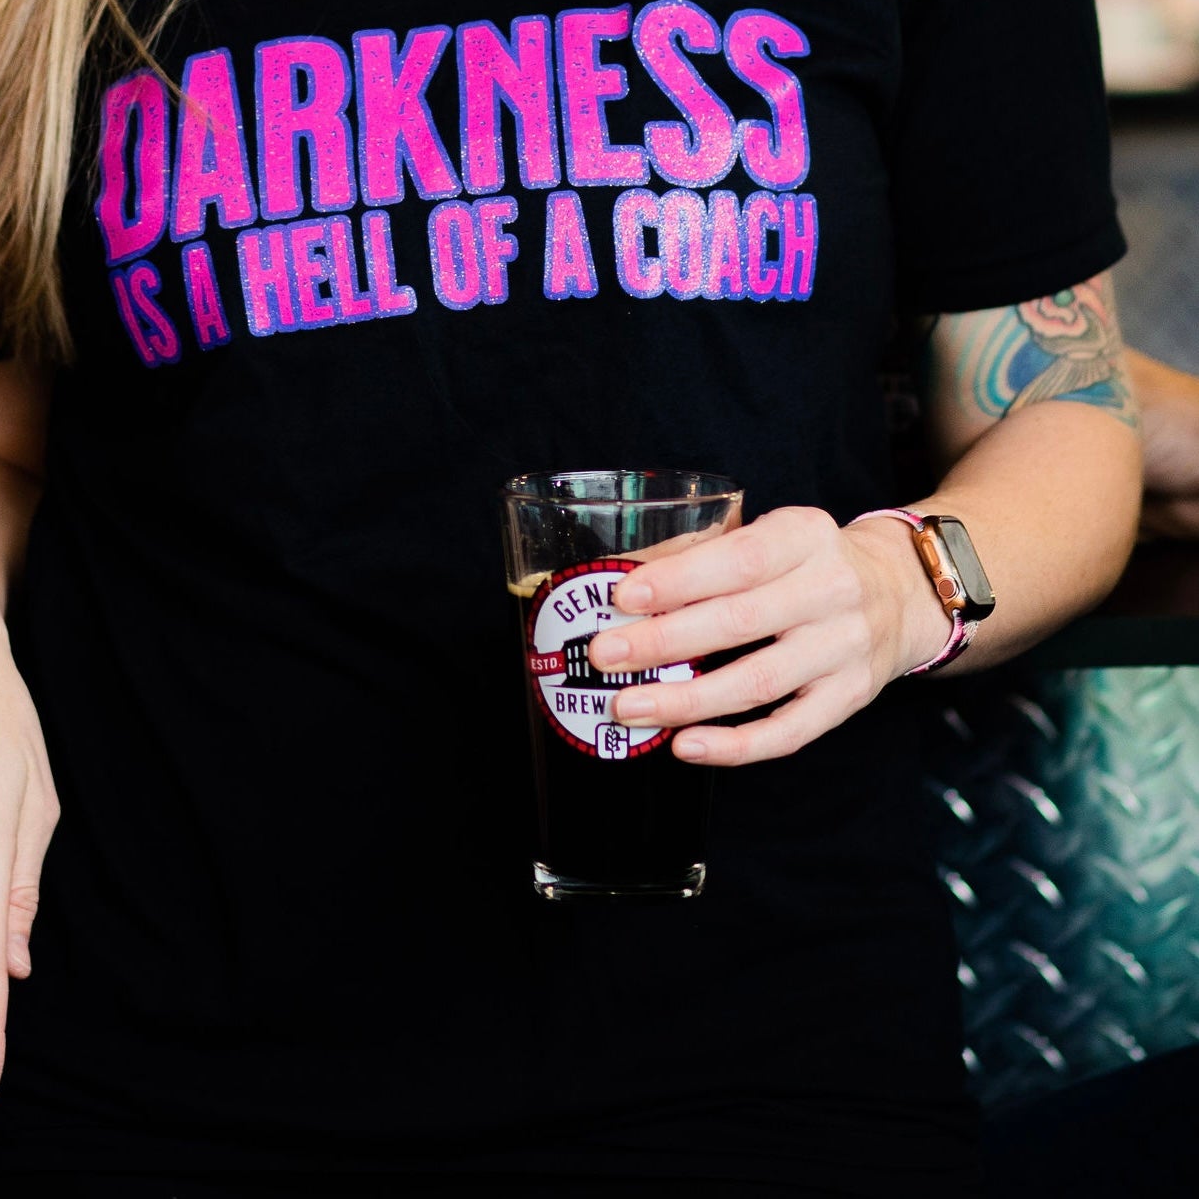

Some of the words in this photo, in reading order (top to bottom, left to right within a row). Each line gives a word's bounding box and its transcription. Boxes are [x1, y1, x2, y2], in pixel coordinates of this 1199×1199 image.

[109, 260, 182, 368] IS
[181, 241, 232, 351] A
[237, 209, 417, 337] HELL
[427, 196, 519, 311] OF
[543, 190, 599, 300] A
[613, 188, 817, 303] COACH
[553, 582, 618, 623] GENE
